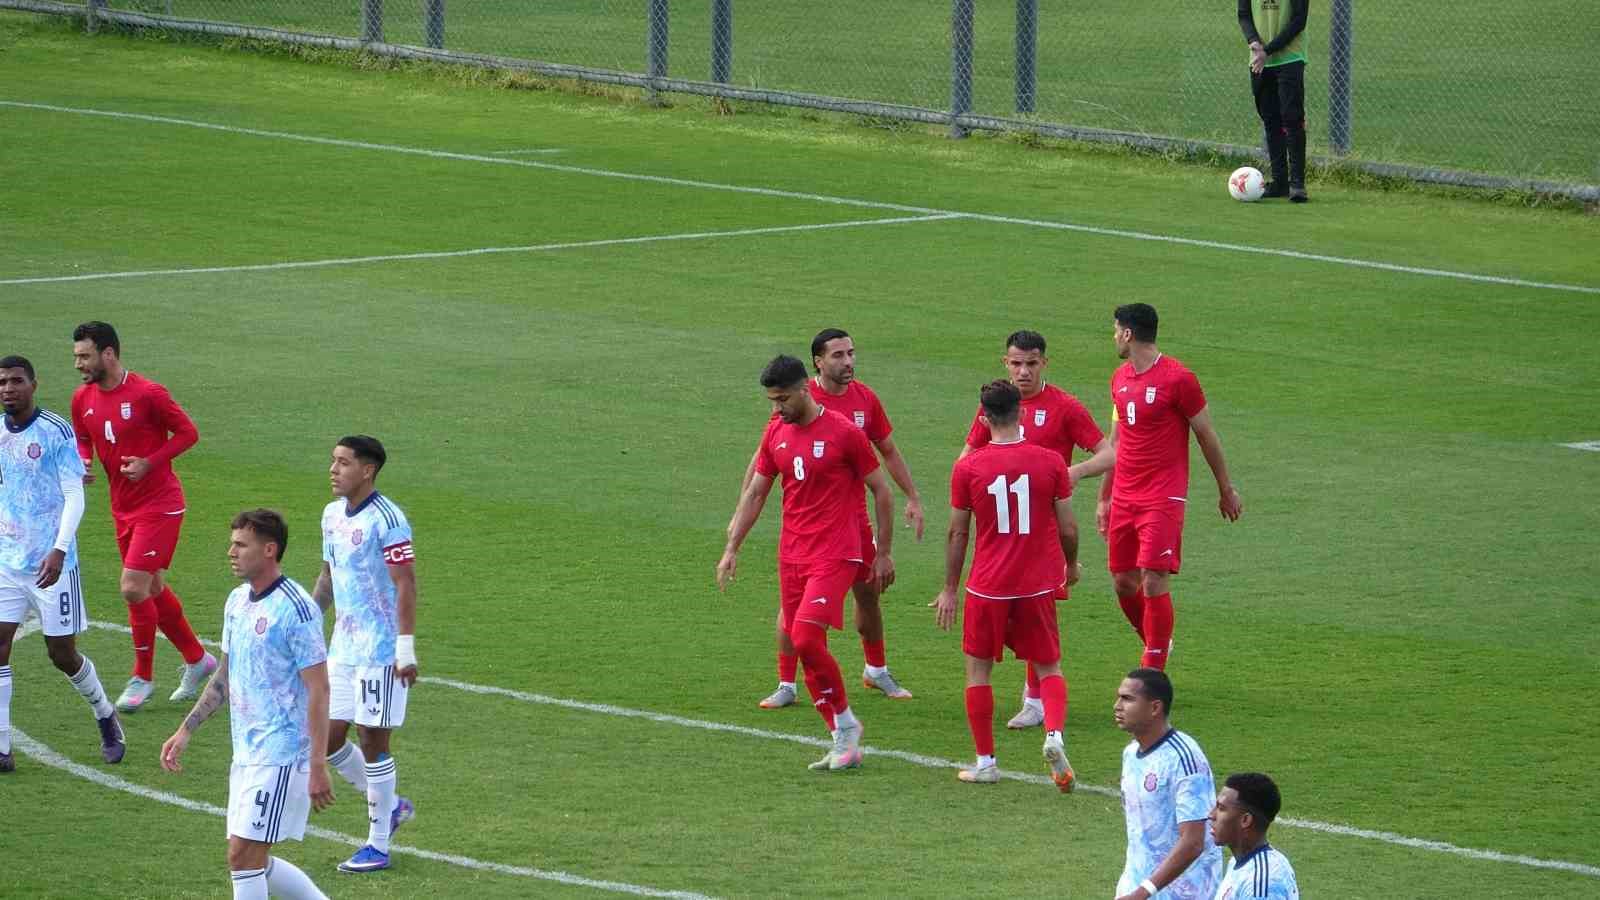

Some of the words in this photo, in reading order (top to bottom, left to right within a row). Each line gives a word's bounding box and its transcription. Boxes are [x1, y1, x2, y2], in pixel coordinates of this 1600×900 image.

[1127, 402, 1136, 425] 9
[105, 421, 116, 443] 4
[794, 456, 805, 481] 8
[987, 474, 1030, 534] 11
[391, 548, 404, 562] C
[60, 592, 70, 616] 8
[361, 679, 380, 704] 14
[255, 790, 270, 817] 4
